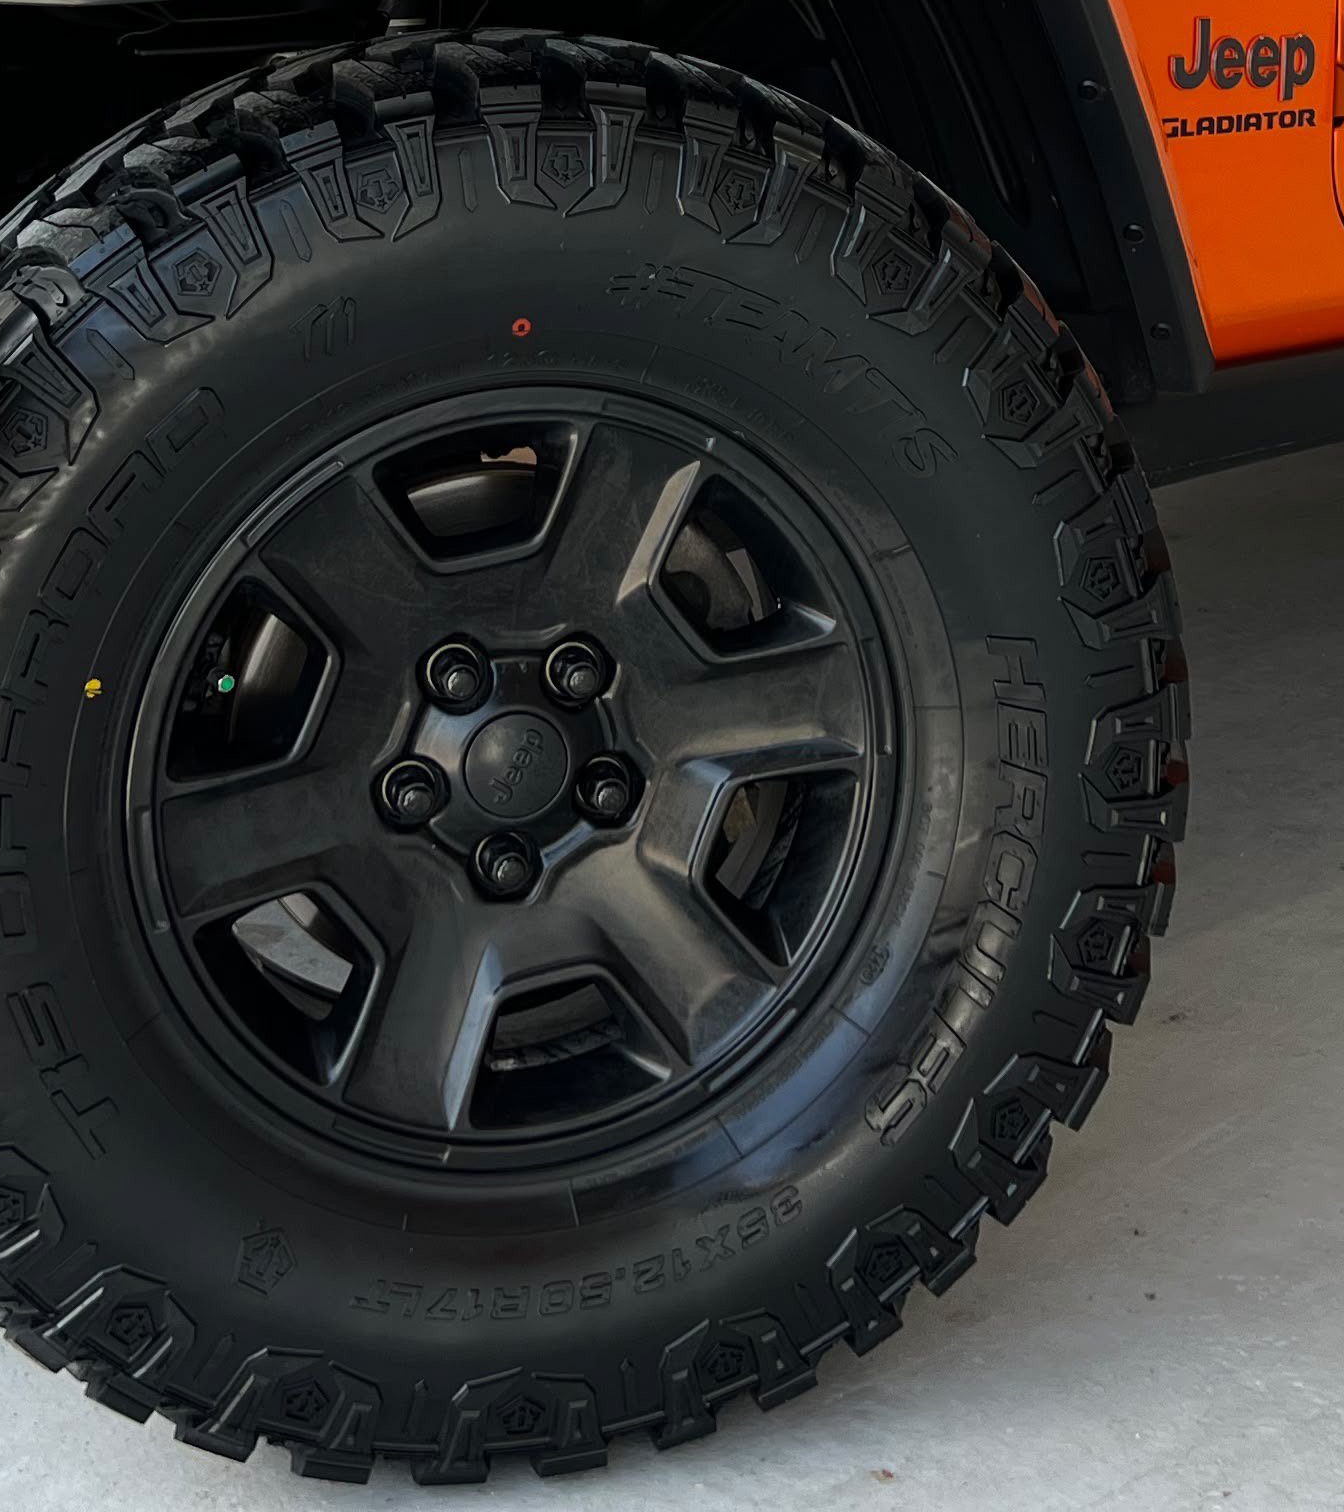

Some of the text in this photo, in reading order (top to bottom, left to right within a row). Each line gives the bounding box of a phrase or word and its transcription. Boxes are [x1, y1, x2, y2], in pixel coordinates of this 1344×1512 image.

[1169, 17, 1315, 101] Jeep
[1161, 108, 1317, 139] GLADIATOR
[488, 728, 544, 805] Jeep
[864, 632, 1049, 1147] HERCULES
